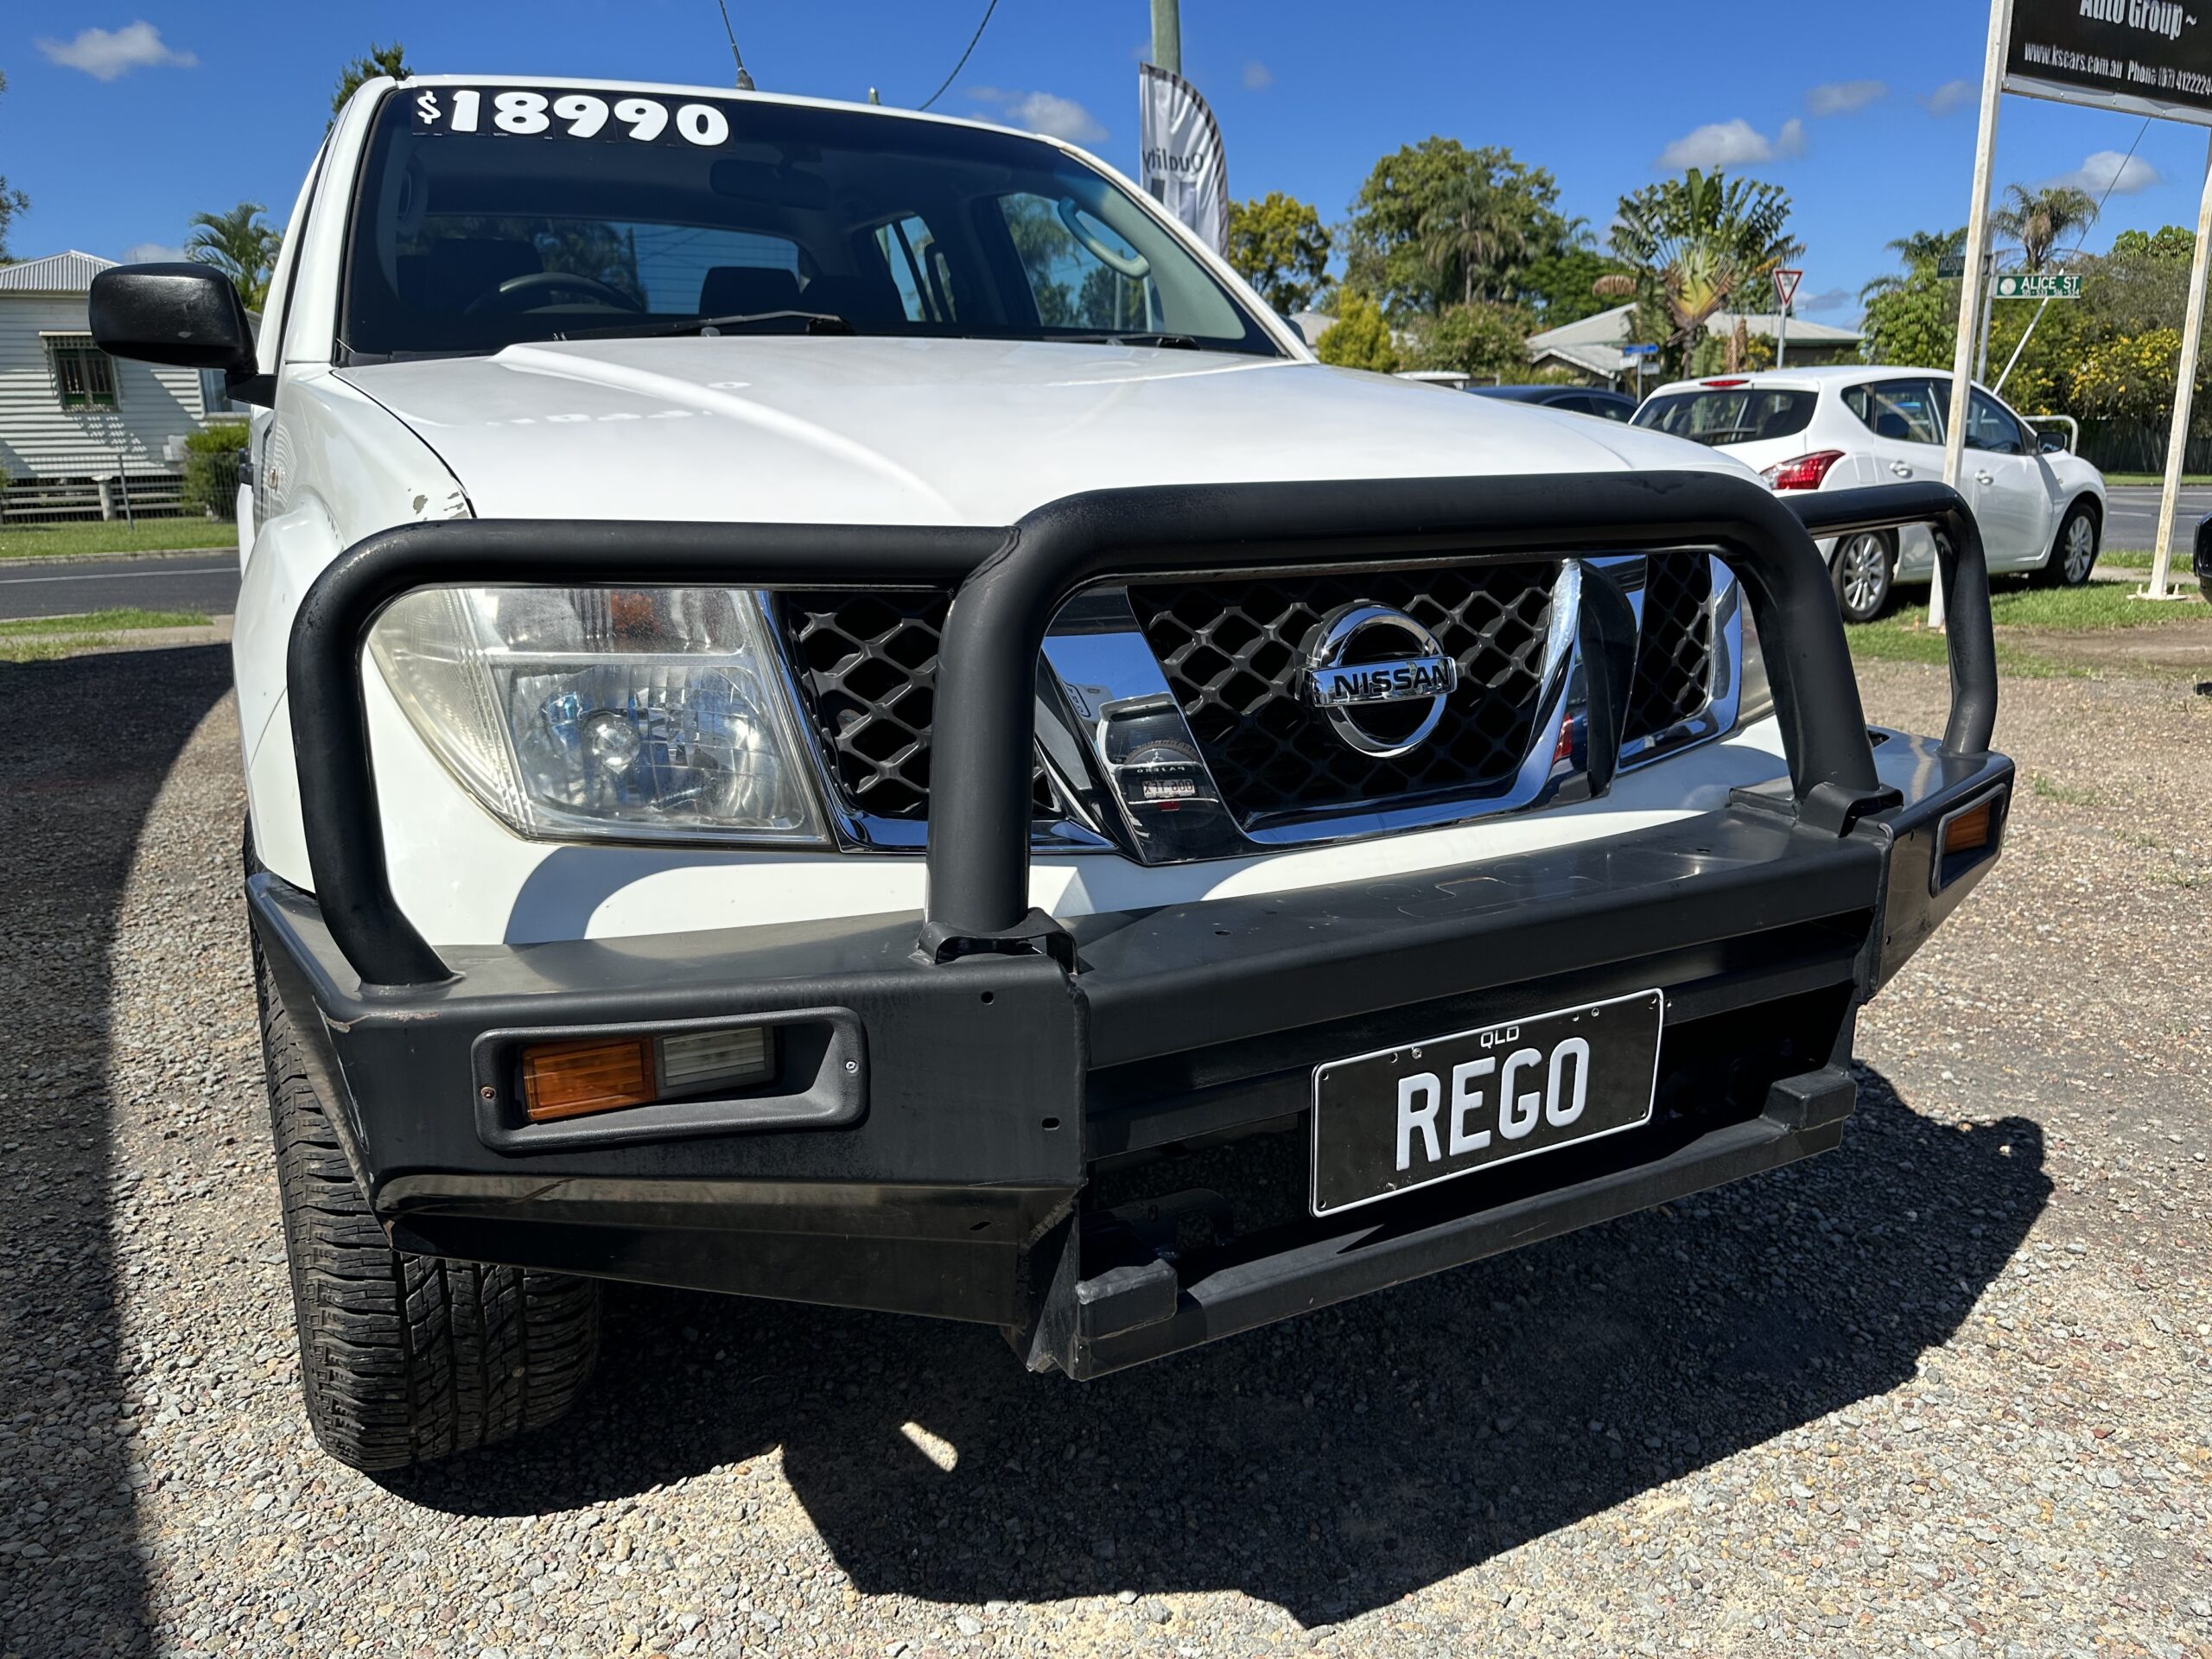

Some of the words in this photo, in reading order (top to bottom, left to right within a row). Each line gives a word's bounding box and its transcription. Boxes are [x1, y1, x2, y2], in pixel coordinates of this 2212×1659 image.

[2129, 0, 2183, 41] Group
[2024, 42, 2122, 79] www.kscars.com.au
[2127, 60, 2157, 86] Phone
[2176, 70, 2212, 97] 4122224
[416, 90, 729, 146] $18990
[2020, 276, 2056, 290] ALICE
[2063, 276, 2080, 290] ST
[1333, 664, 1449, 697] NISSAN
[1480, 1025, 1520, 1049] QLD
[1395, 1037, 1590, 1172] REGO
